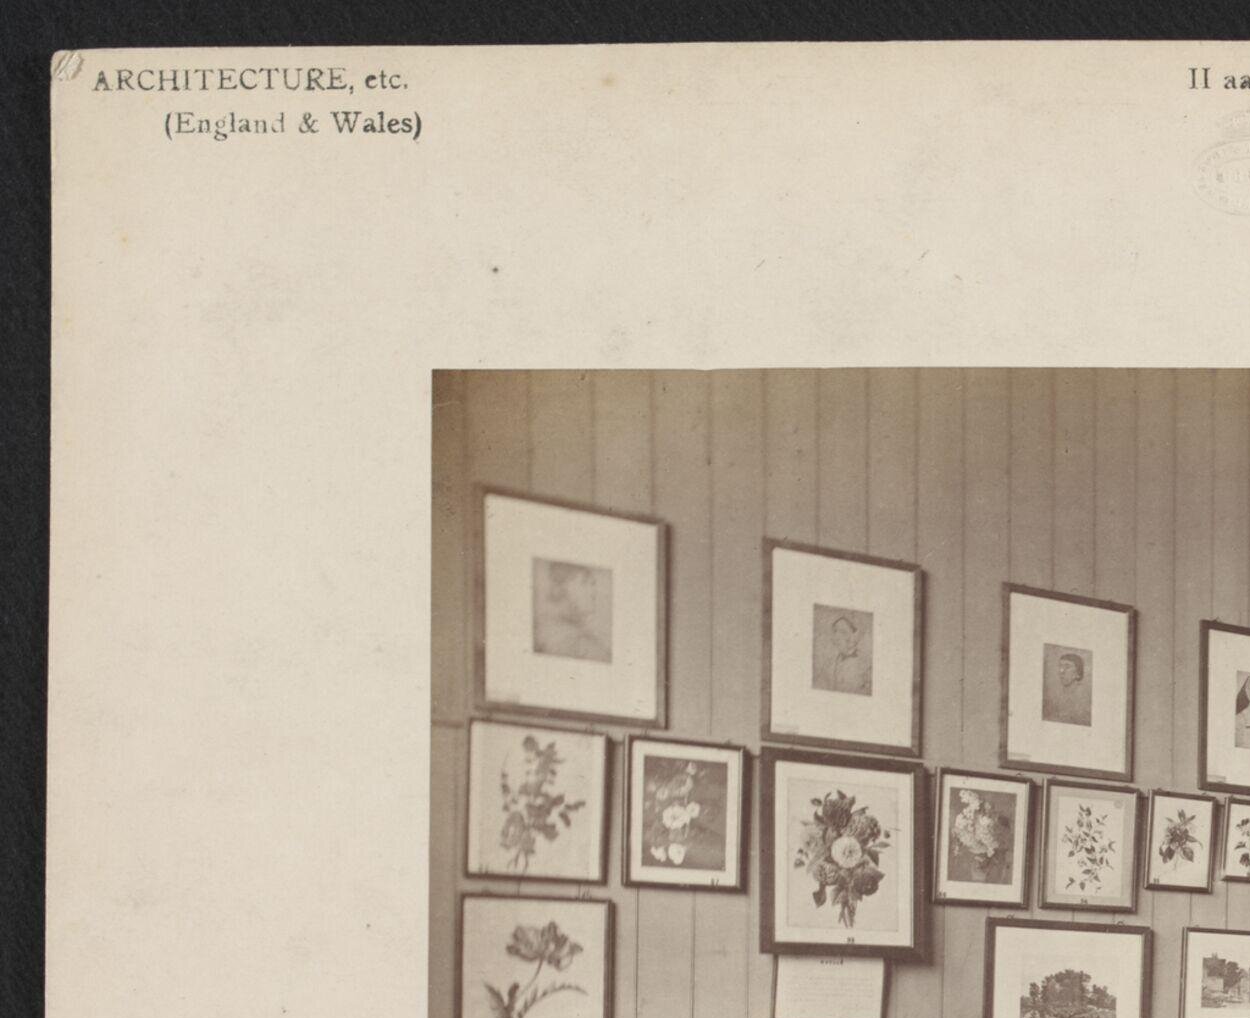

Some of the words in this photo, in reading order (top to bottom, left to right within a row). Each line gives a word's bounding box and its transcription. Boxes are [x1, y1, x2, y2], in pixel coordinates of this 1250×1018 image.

[92, 68, 354, 94] ARCHITECTURE,
[365, 70, 408, 89] etc.
[1189, 68, 1210, 89] II
[165, 112, 284, 141] (England
[298, 112, 319, 134] &
[330, 111, 422, 141] Wales)
